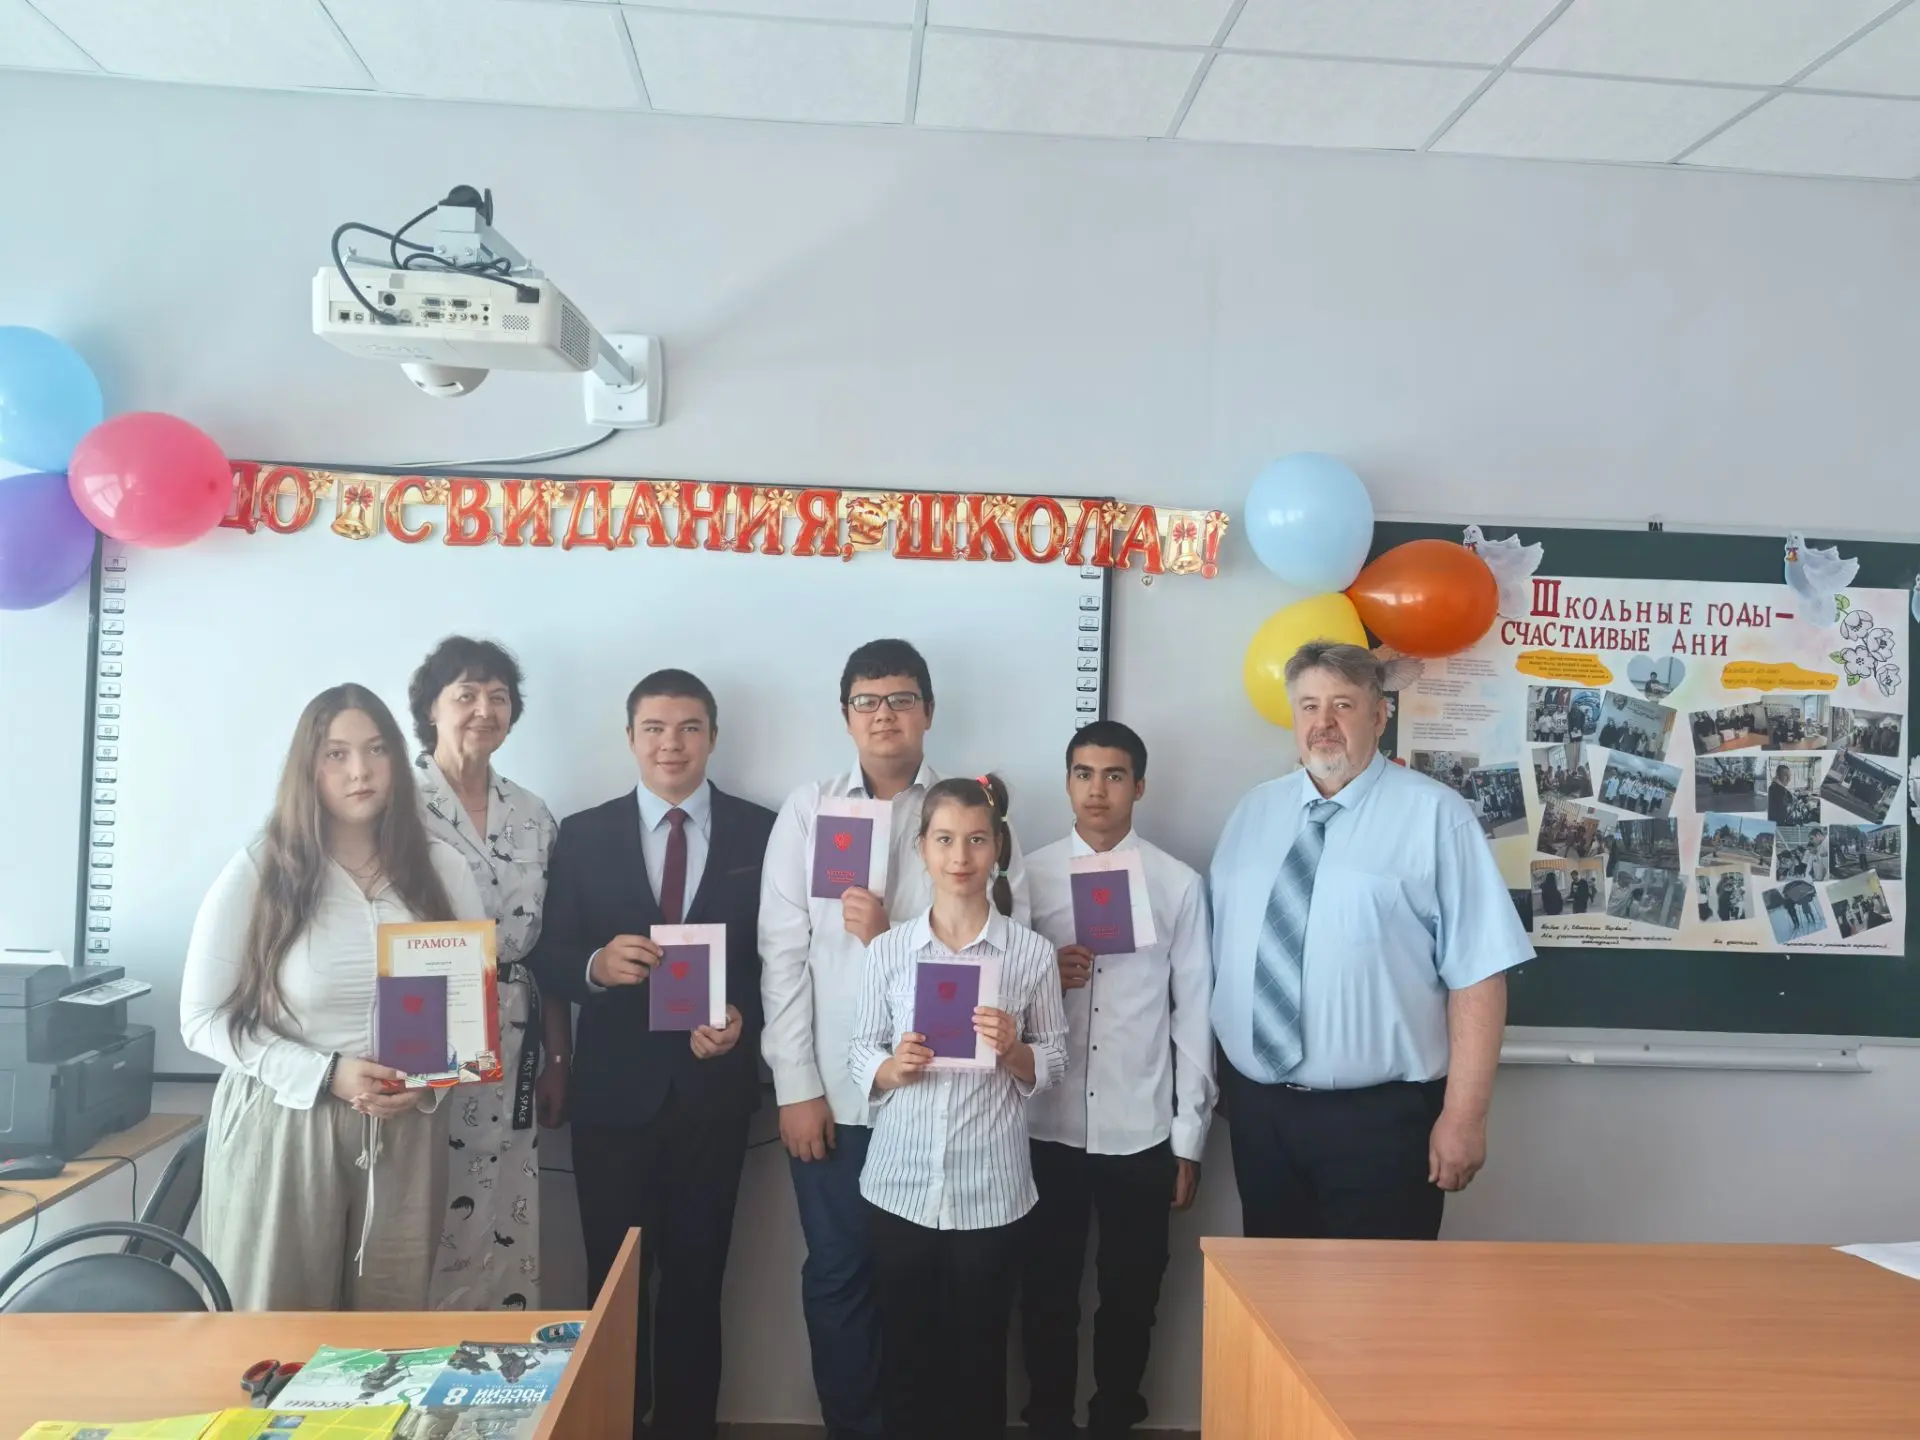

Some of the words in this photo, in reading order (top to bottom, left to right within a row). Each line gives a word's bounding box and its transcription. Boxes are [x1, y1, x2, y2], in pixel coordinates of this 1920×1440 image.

[1501, 620, 1650, 652] СЧАСТЛИВЫЕ
[1672, 628, 1728, 656] ДНИ
[407, 937, 467, 950] ГРАМОТА
[522, 1051, 535, 1079] FIRST
[521, 1081, 531, 1091] IN
[518, 1095, 529, 1123] SPACE
[442, 1387, 469, 1406] 8
